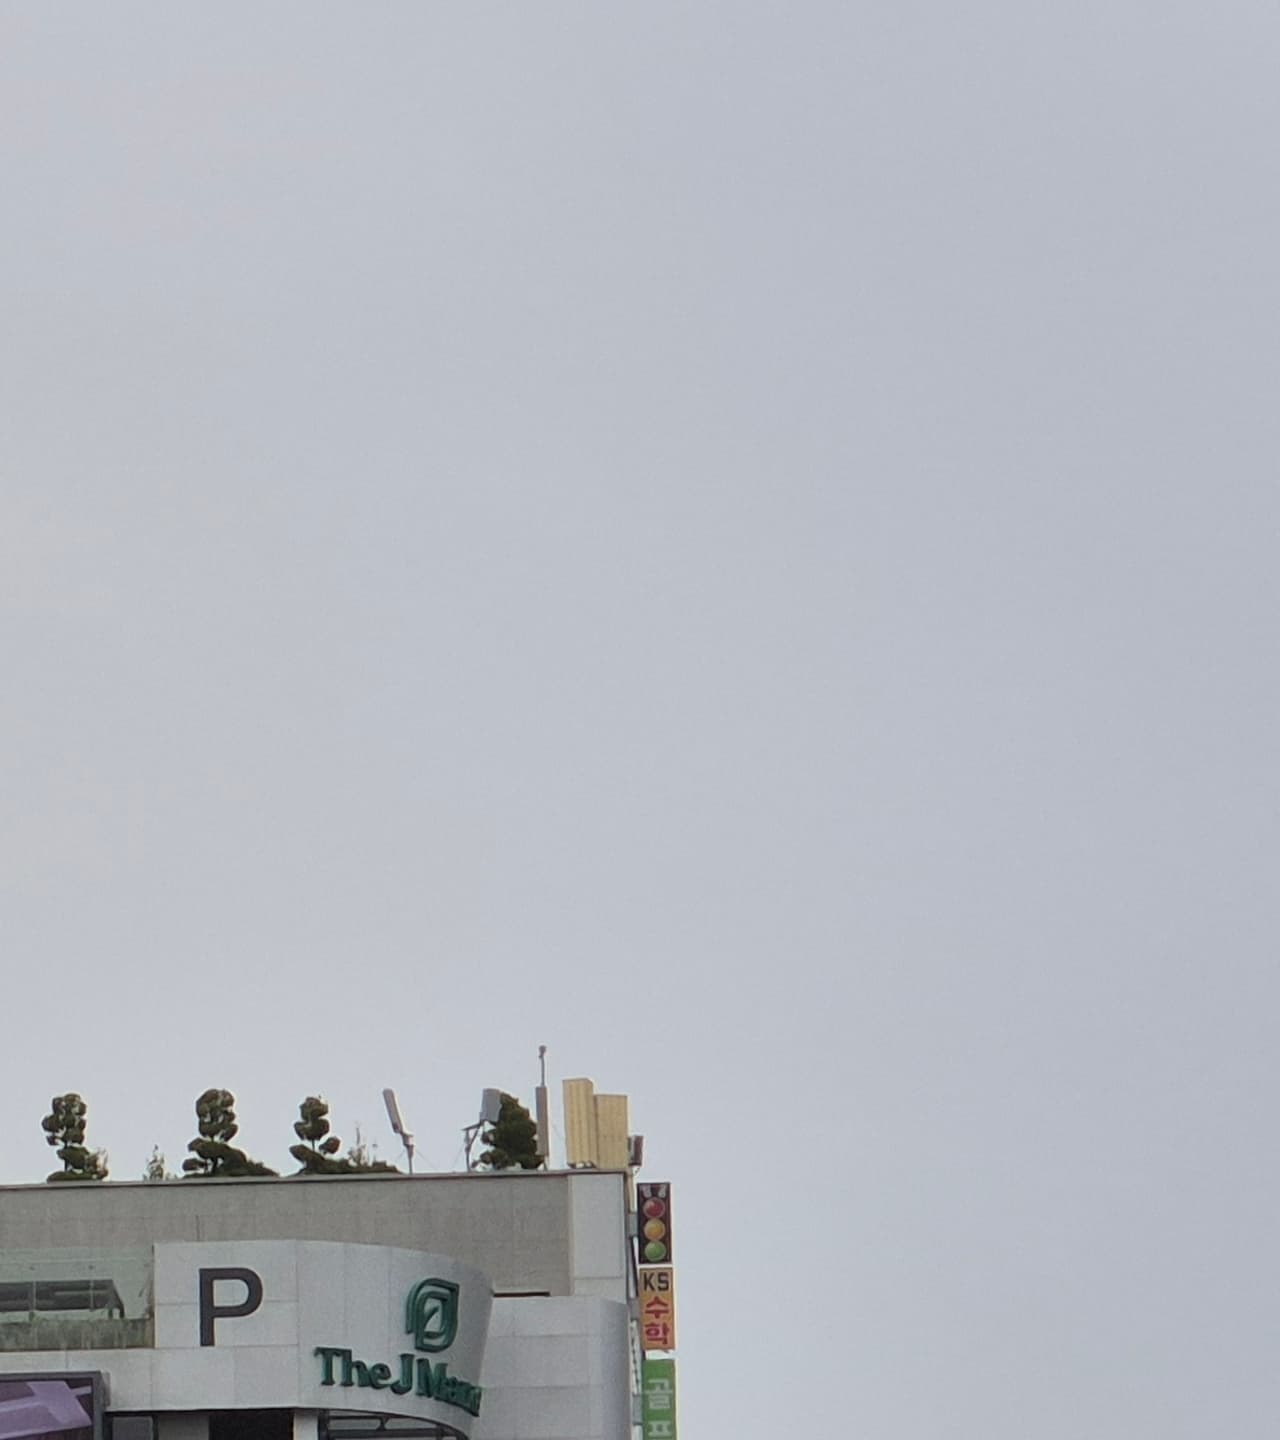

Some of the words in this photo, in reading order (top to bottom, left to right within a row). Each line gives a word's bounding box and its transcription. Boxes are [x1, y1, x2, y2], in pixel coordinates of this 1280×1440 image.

[643, 1272, 669, 1291] KS
[199, 1267, 263, 1347] P
[644, 1296, 670, 1345] 수학
[313, 1347, 391, 1389] The
